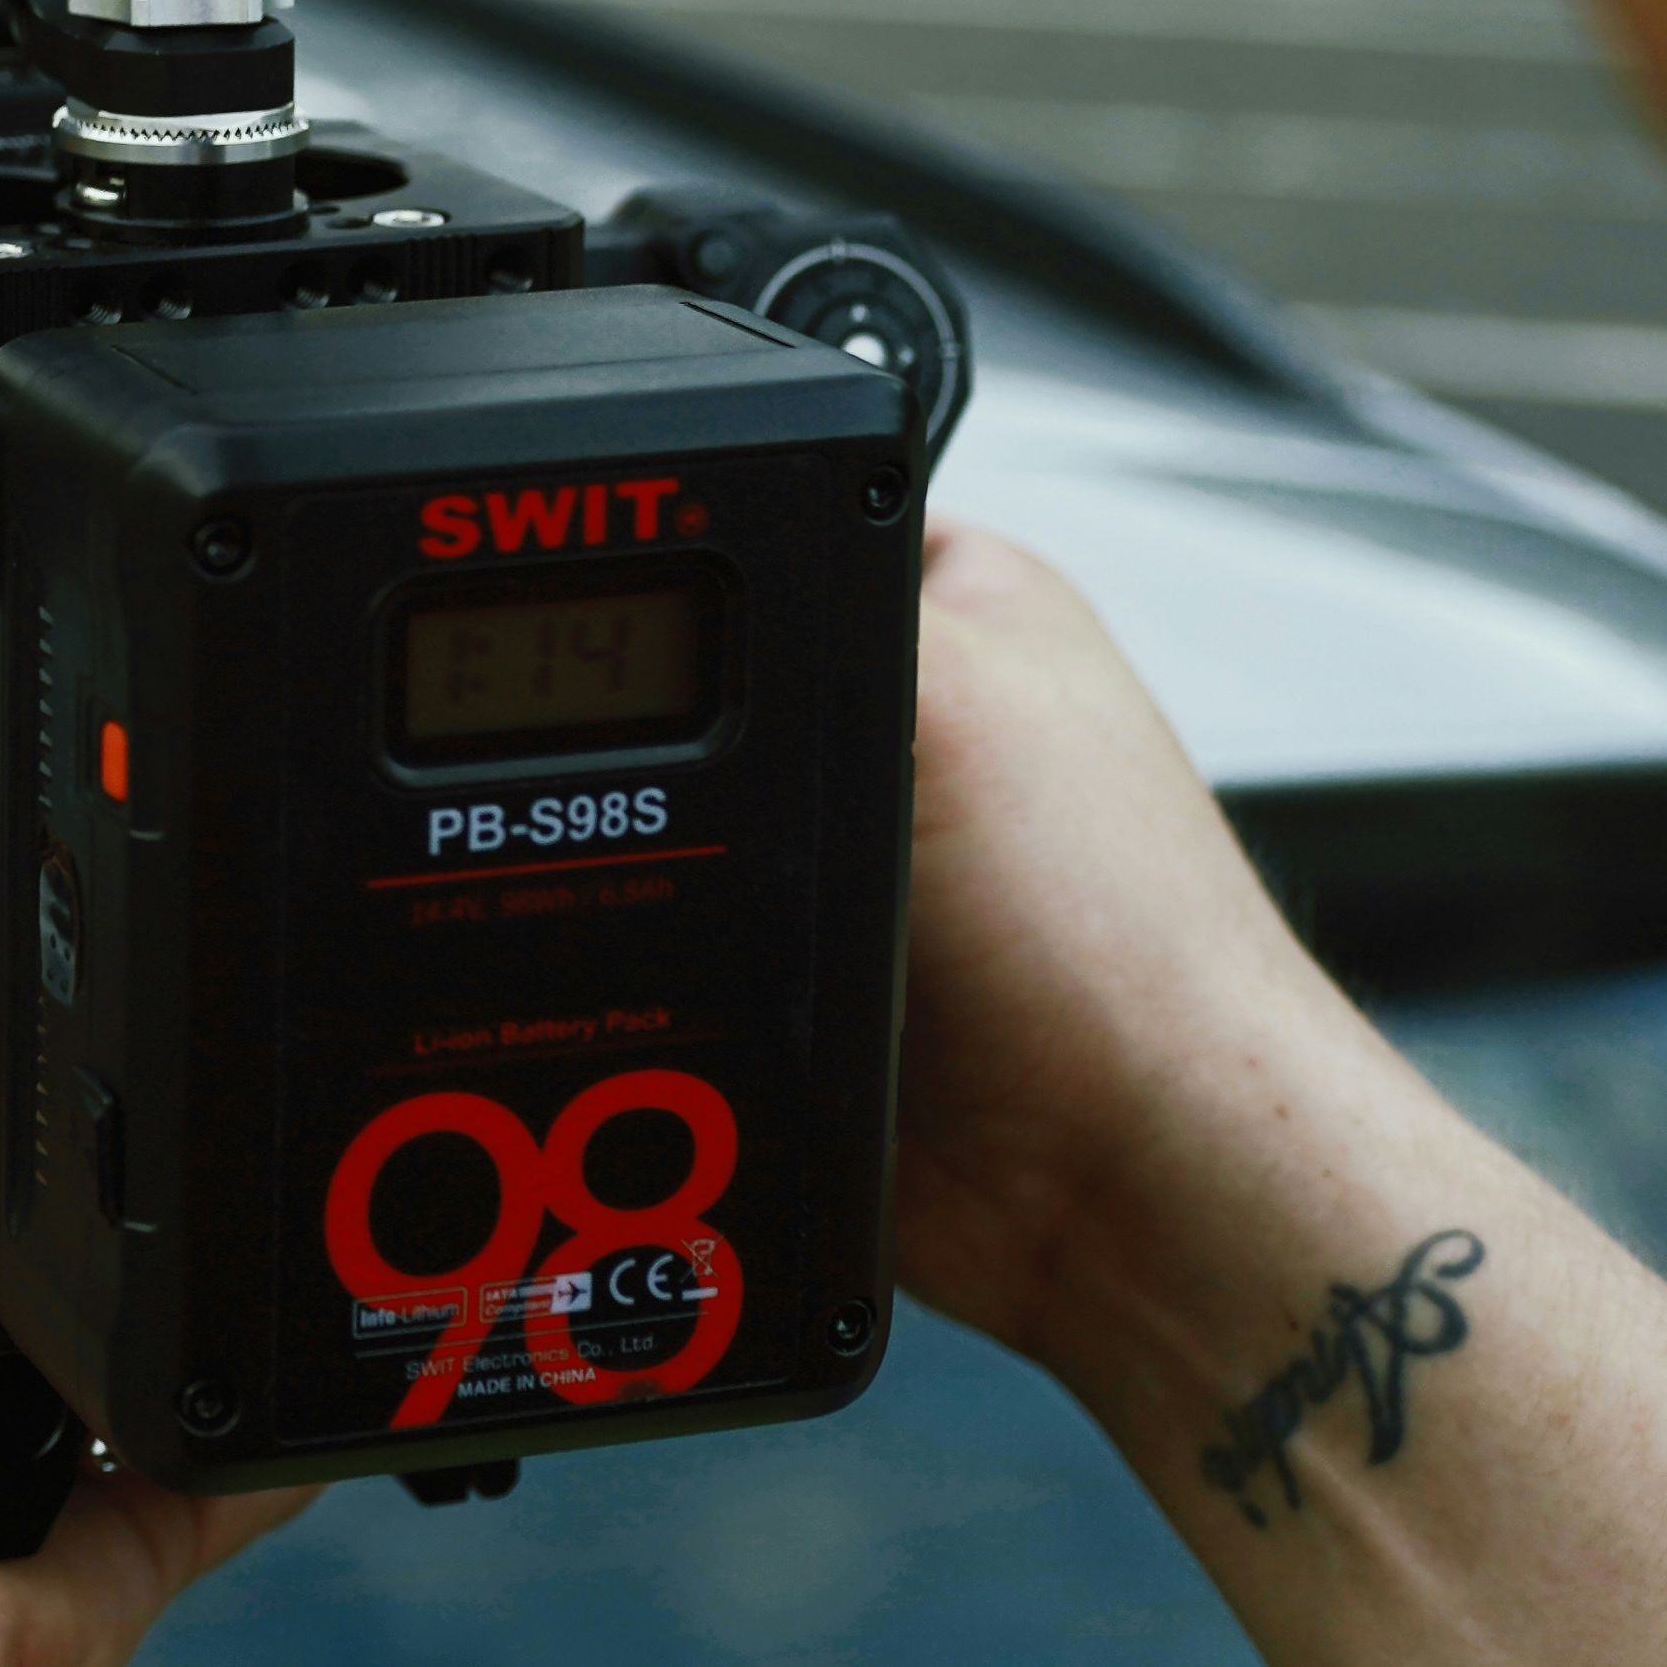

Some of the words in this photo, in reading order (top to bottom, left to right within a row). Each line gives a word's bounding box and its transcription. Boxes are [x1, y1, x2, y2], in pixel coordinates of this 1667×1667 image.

[418, 477, 679, 560] SWIT
[427, 786, 669, 856] PB-S98S
[323, 1067, 744, 1429] 98
[405, 1356, 455, 1381] SWIT
[463, 1347, 570, 1374] Electronics
[456, 1376, 512, 1399] MADE
[516, 1373, 535, 1392] IN
[539, 1366, 598, 1388] CHINA
